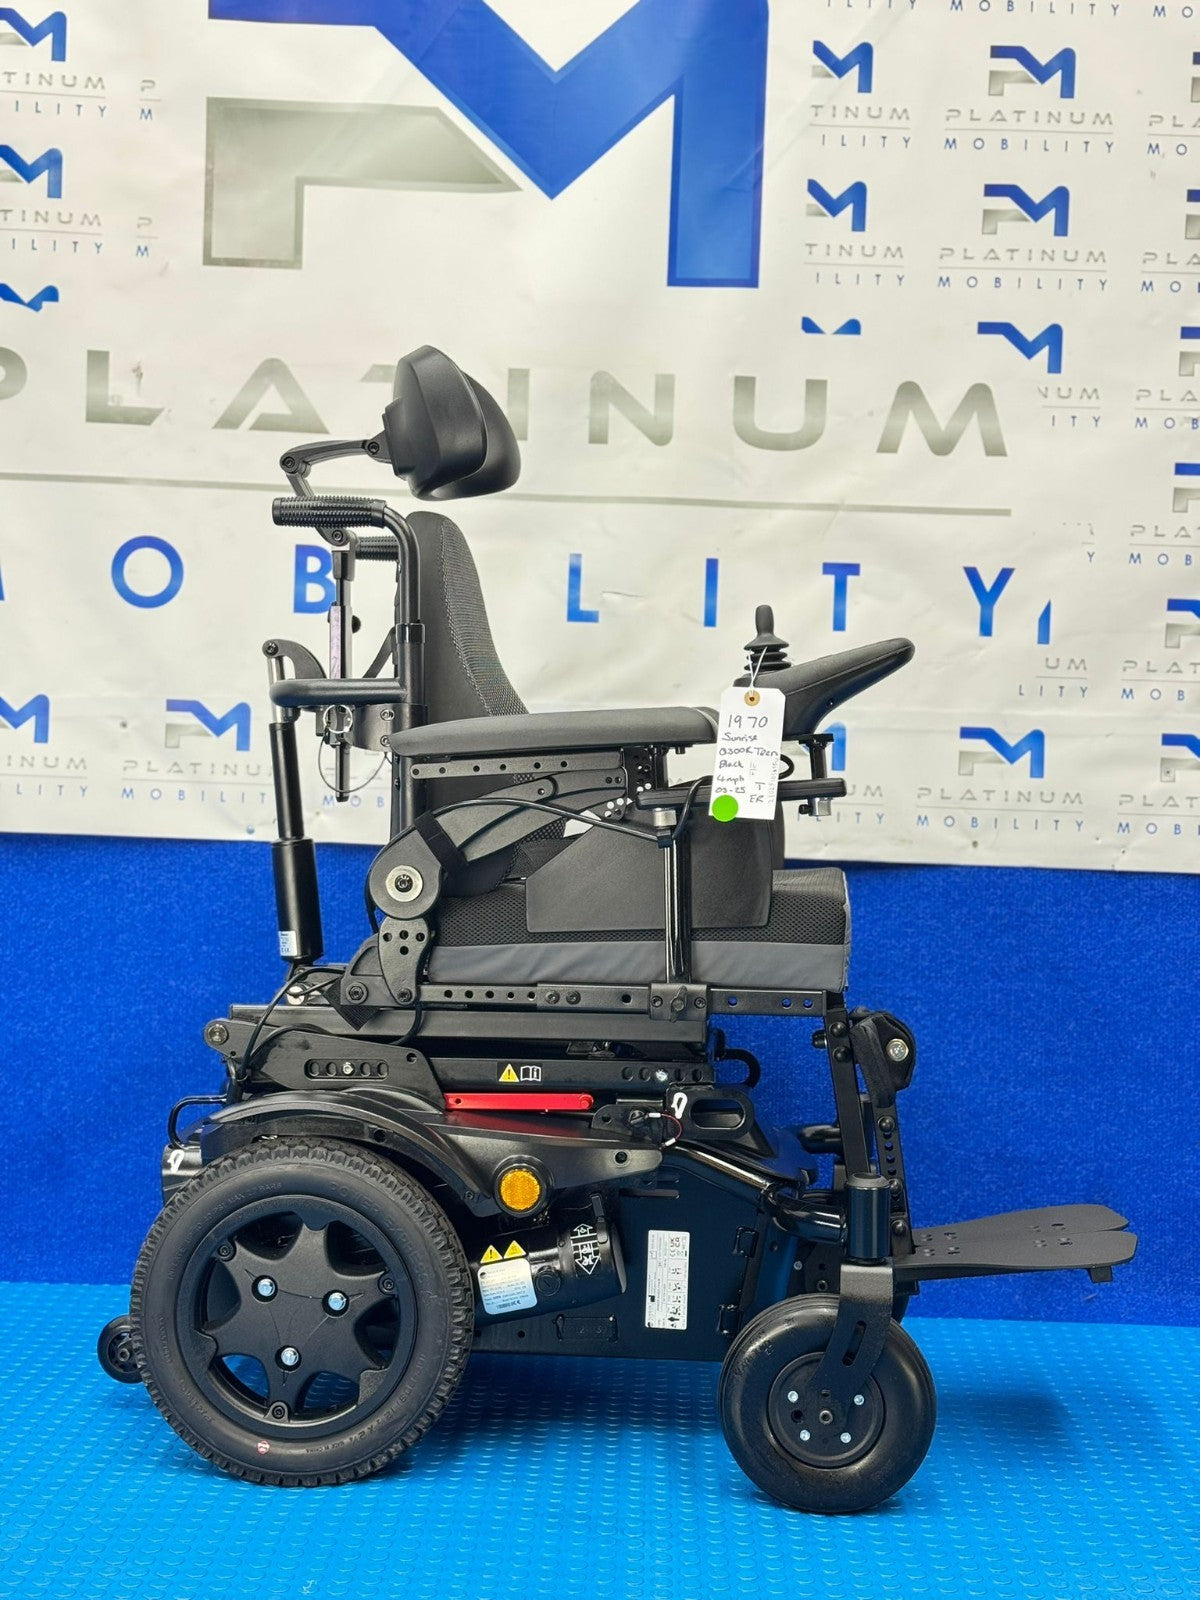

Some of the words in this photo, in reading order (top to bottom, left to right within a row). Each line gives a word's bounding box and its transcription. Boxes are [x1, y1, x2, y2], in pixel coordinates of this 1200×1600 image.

[1153, 5, 1193, 18] MO
[2, 71, 106, 90] TINUM
[15, 100, 106, 118] ILITY
[811, 104, 911, 121] TINUM
[945, 109, 1113, 126] PLATINUM
[821, 134, 911, 148] ILITY
[944, 138, 1114, 154] MOBILITY
[1147, 143, 1187, 156] MO
[12, 238, 103, 254] ILITY
[805, 243, 904, 259] TINUM
[939, 248, 1106, 263] PLATINUM
[815, 272, 905, 286] ILITY
[938, 276, 1107, 290] MOBILITY
[1141, 281, 1200, 294] MO
[1130, 525, 1200, 538] PLA
[1129, 553, 1193, 566] MOB
[1121, 688, 1185, 701] MOB
[728, 715, 768, 729] 1970
[122, 760, 273, 777] PLATINU
[916, 787, 1084, 805] PLATINUM
[916, 815, 1084, 831] MOBILITY
